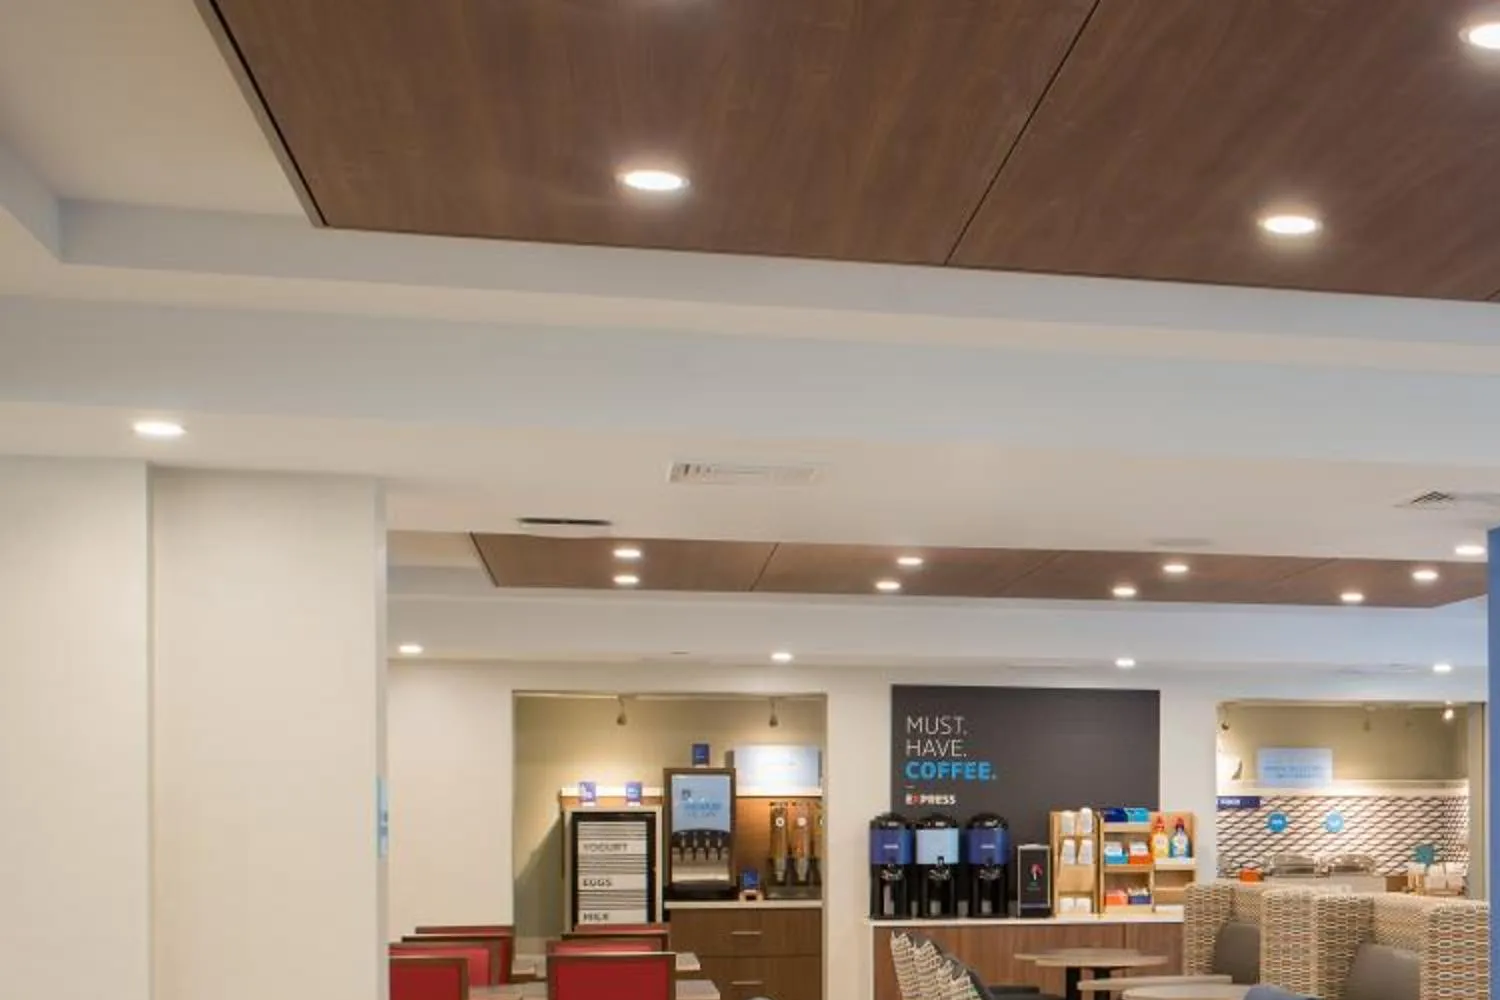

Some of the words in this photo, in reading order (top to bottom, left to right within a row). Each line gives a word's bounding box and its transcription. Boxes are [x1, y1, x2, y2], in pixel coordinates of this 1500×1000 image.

[906, 715, 967, 735] MUST.
[905, 739, 967, 757] HAVE.
[905, 760, 998, 780] COFFEE.
[583, 879, 612, 887] EGGS
